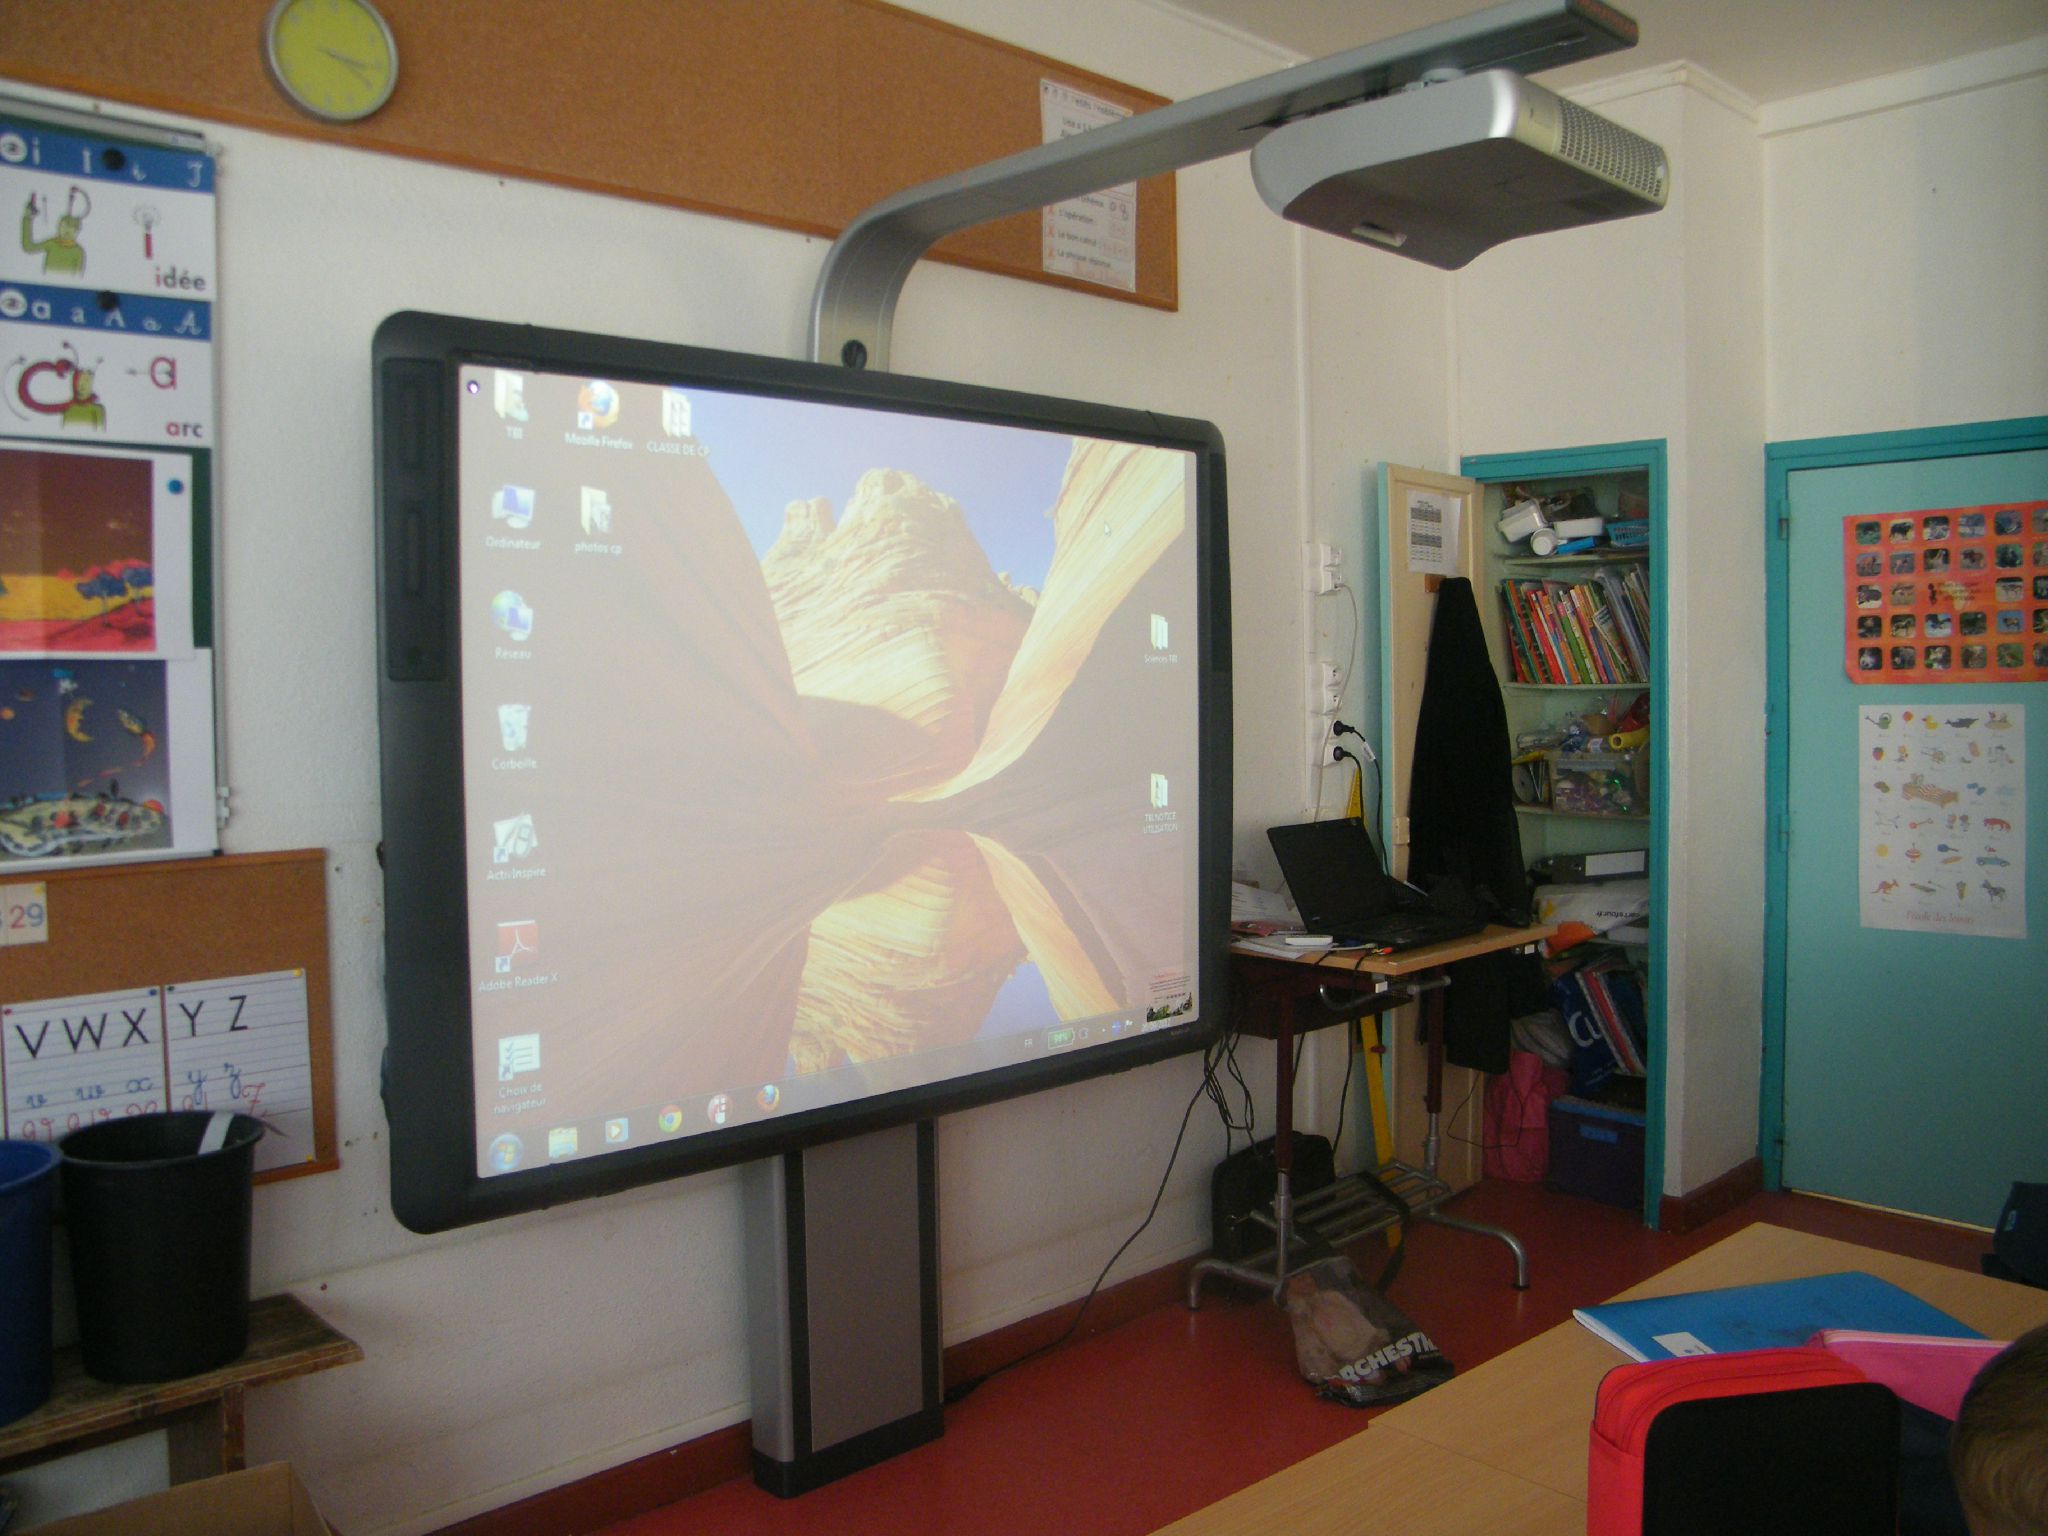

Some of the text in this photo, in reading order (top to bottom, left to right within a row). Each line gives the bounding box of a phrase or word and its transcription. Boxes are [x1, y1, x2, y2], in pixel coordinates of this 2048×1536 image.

[155, 265, 206, 291] idée
[165, 421, 203, 438] arc
[479, 979, 513, 992] Adobe
[514, 974, 548, 988] Reader
[178, 994, 249, 1038] Y Z
[15, 1006, 150, 1059] V W X
